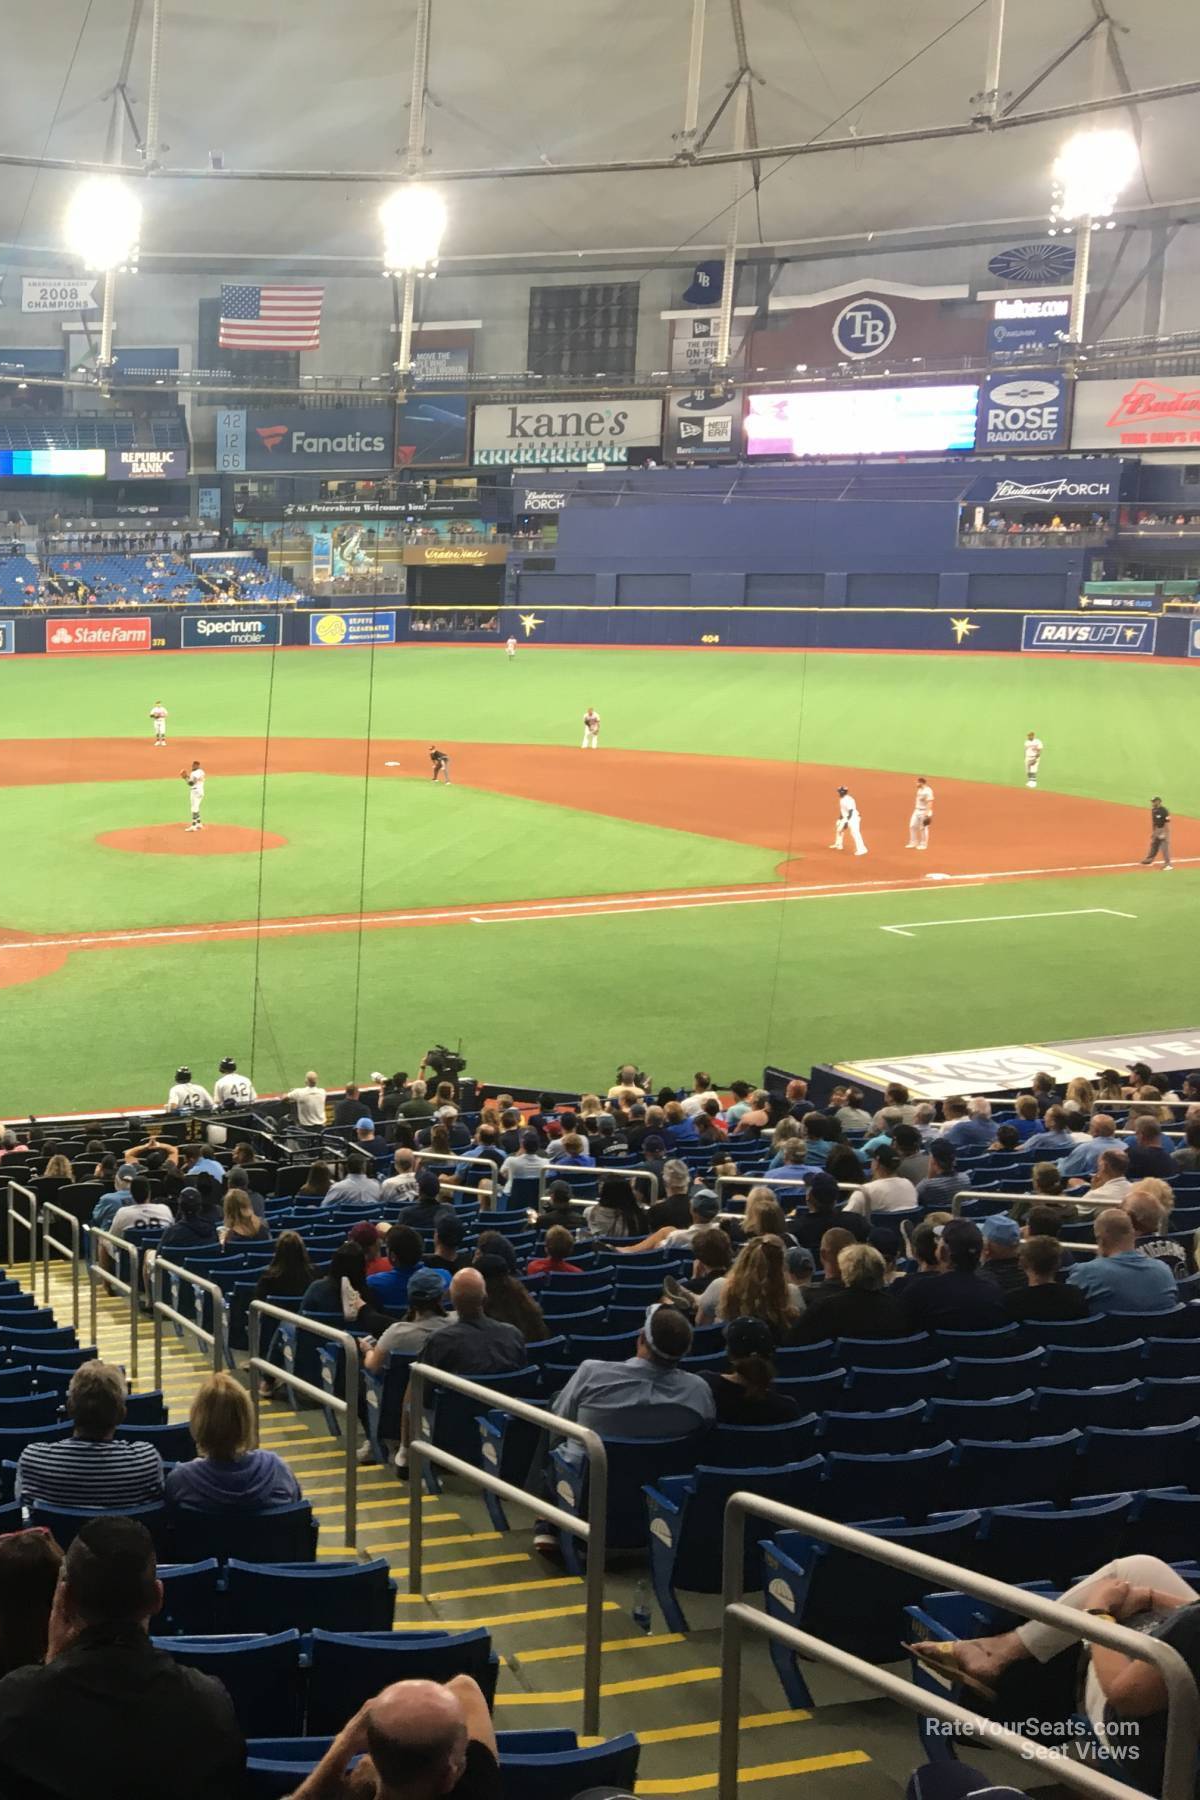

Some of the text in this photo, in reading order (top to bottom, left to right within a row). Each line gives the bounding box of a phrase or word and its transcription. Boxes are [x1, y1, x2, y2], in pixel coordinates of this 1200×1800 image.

[696, 271, 710, 288] TB
[39, 288, 79, 301] 2008
[27, 300, 89, 310] CHAMPIONS
[845, 310, 886, 347] TB
[222, 414, 241, 429] 42
[506, 406, 629, 440] kane's
[708, 421, 729, 429] NEW
[987, 407, 1059, 431] ROSE
[708, 429, 728, 437] ERA
[986, 428, 1057, 443] RADIOLOGY
[224, 433, 240, 449] 12
[291, 431, 386, 453] Fanatics
[120, 452, 175, 464] REPUBLIC
[221, 454, 241, 468] 66
[131, 462, 164, 473] BANK
[1058, 483, 1110, 496] PORCH
[310, 504, 362, 514] Petersburg
[364, 503, 406, 512] Welcomes
[408, 502, 428, 511] You!
[524, 499, 566, 510] PORCH
[196, 619, 263, 637] Spectrum
[230, 632, 263, 644] mobile
[865, 1054, 1064, 1088] RAYS
[230, 1082, 249, 1098] 42
[183, 1093, 201, 1108] 42
